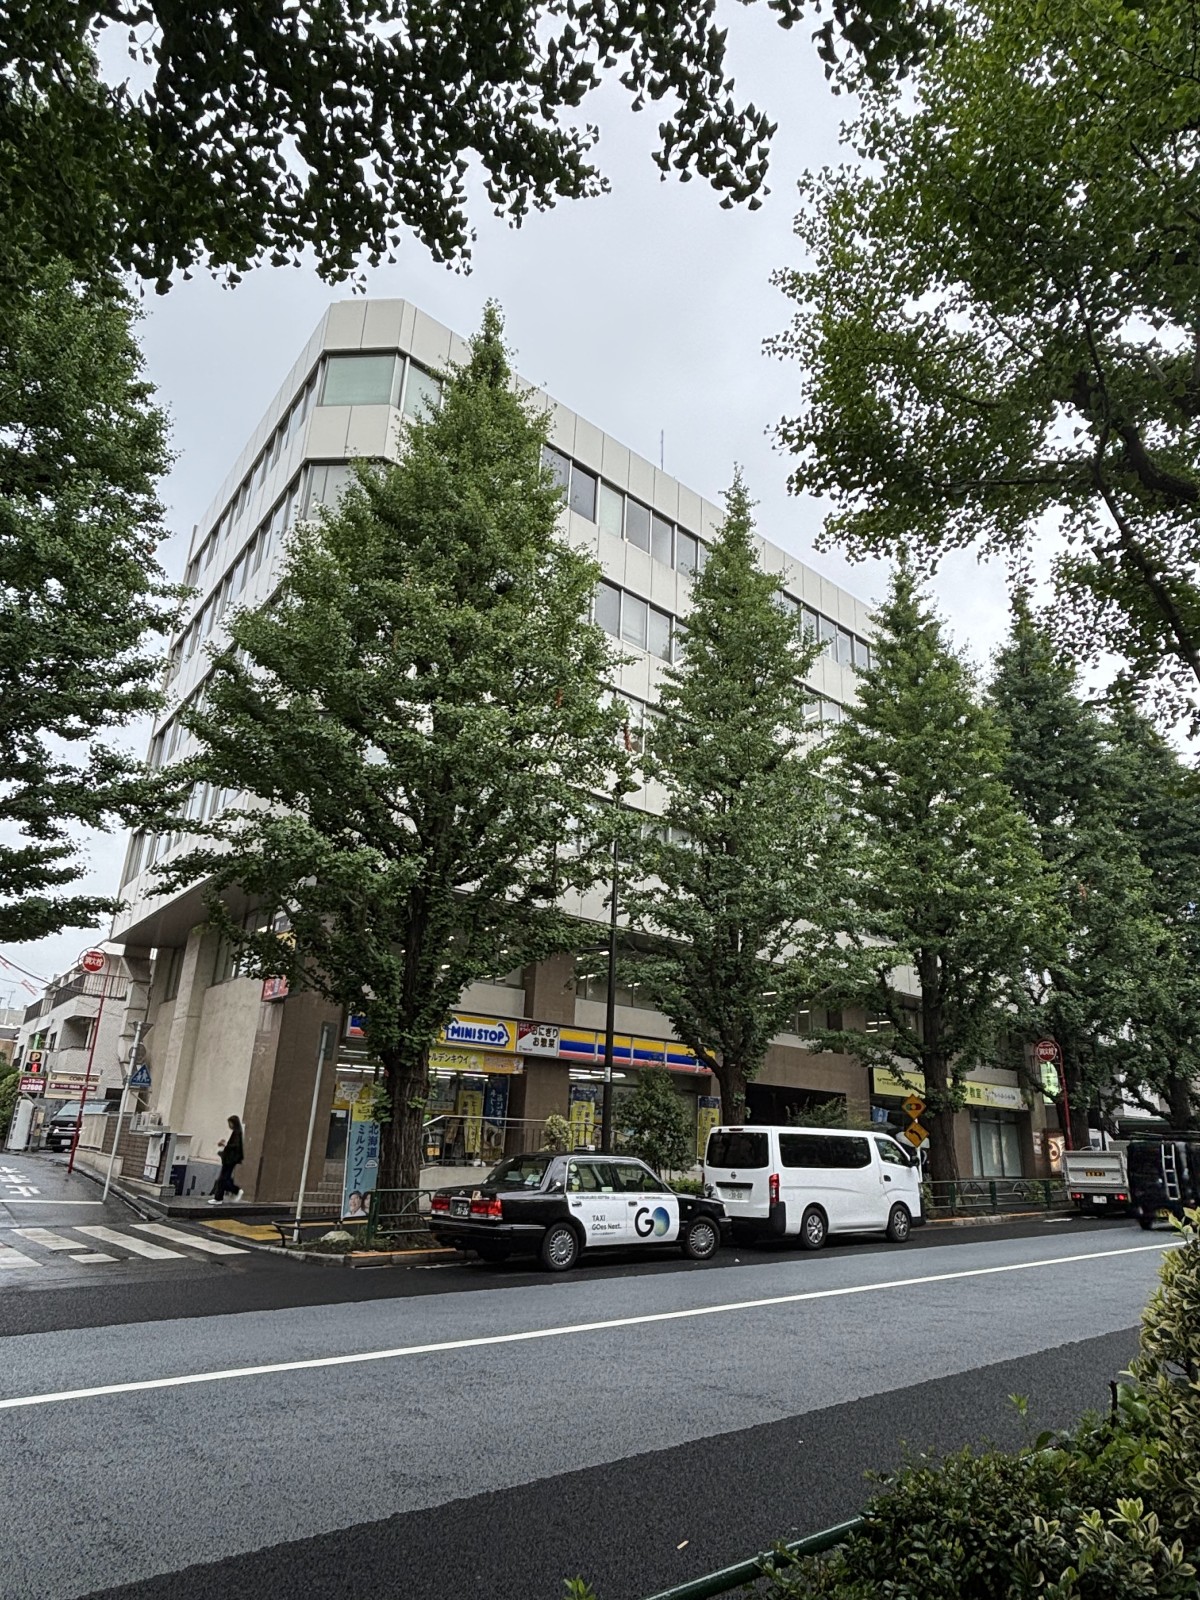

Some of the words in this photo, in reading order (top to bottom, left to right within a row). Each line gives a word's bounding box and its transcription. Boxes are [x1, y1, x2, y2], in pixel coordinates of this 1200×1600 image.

[451, 1025, 504, 1042] MINISTOP
[531, 1025, 558, 1038] おにぎり
[533, 1037, 555, 1048] お惣菜
[367, 1122, 378, 1158] 北海道
[353, 1125, 365, 1189] ミルクソフト
[591, 1214, 606, 1222] TAXI
[634, 1206, 670, 1238] GO
